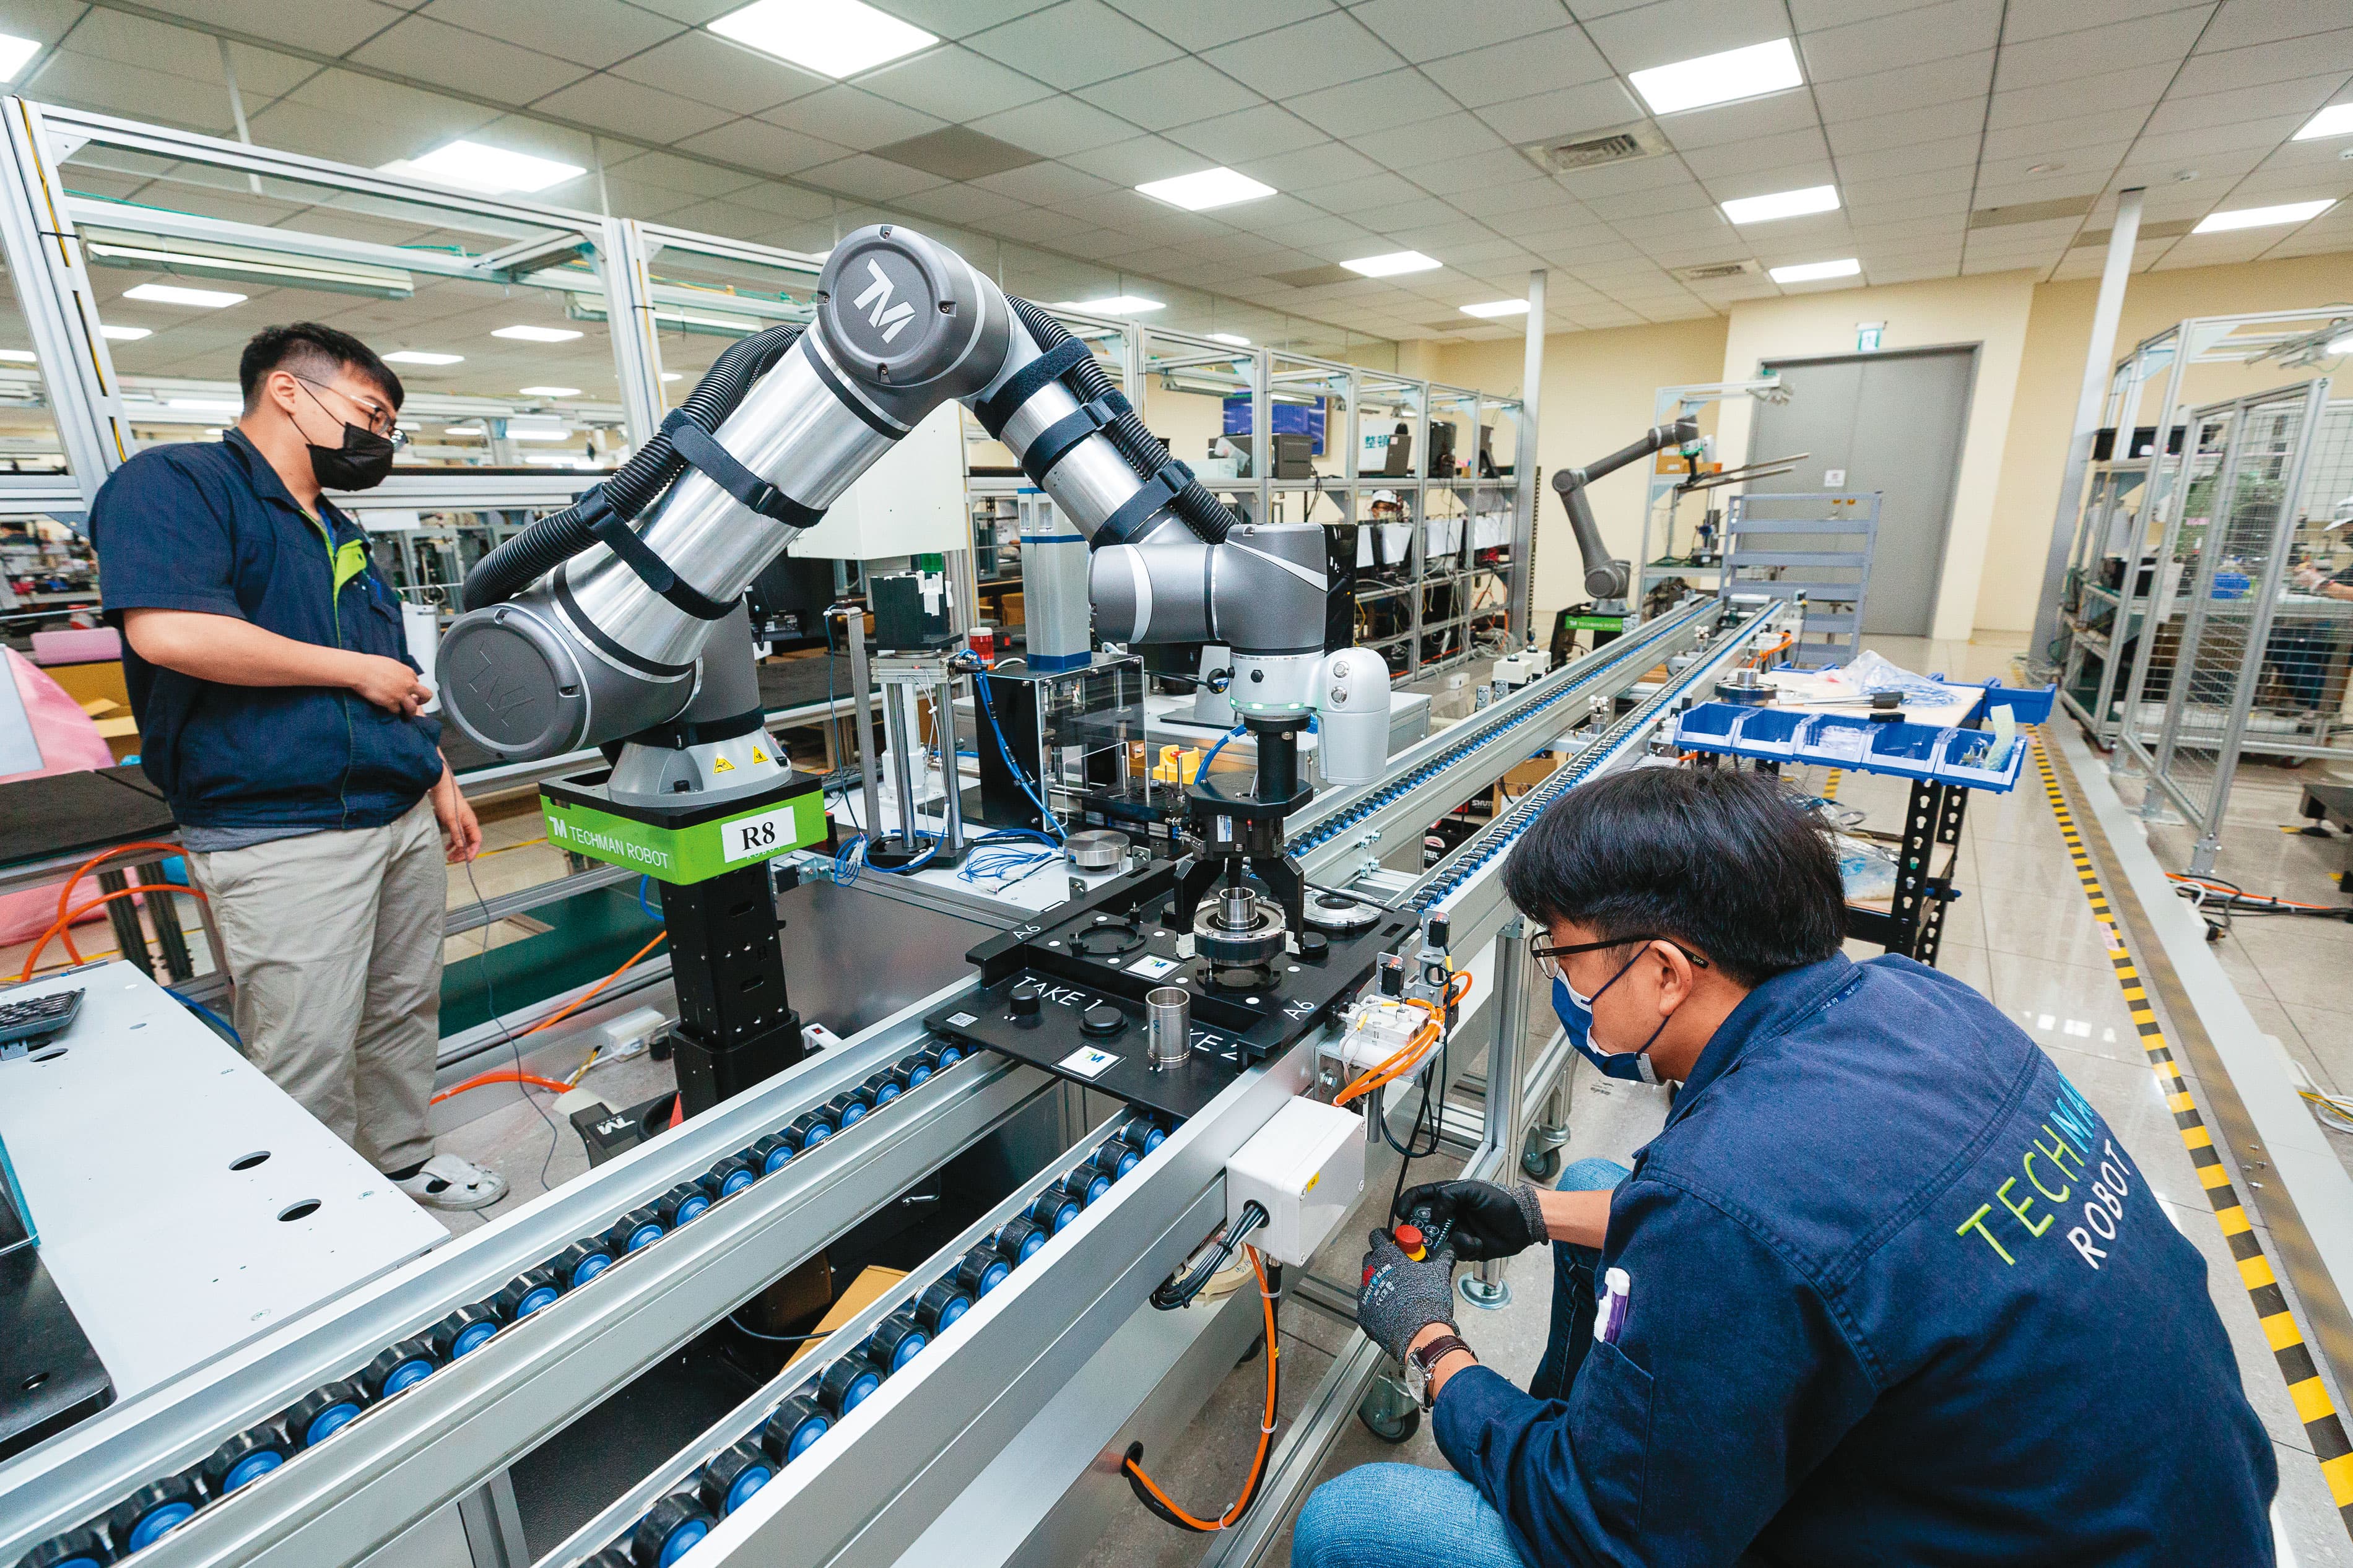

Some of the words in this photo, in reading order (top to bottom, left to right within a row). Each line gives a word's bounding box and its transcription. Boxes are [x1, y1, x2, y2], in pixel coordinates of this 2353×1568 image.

[853, 258, 916, 344] TM
[548, 816, 567, 839] TM
[568, 826, 625, 856] TECHMAN
[626, 842, 669, 869] ROBOT
[739, 821, 775, 851] R8
[1013, 924, 1041, 940] A6
[1014, 976, 1086, 1006] TAKE
[1084, 998, 1103, 1011] 1
[1283, 1000, 1315, 1021] A6
[2067, 1138, 2130, 1270] ROBOT
[1362, 1283, 1375, 1306] SAFETY
[1376, 1263, 1393, 1278] GLOVE
